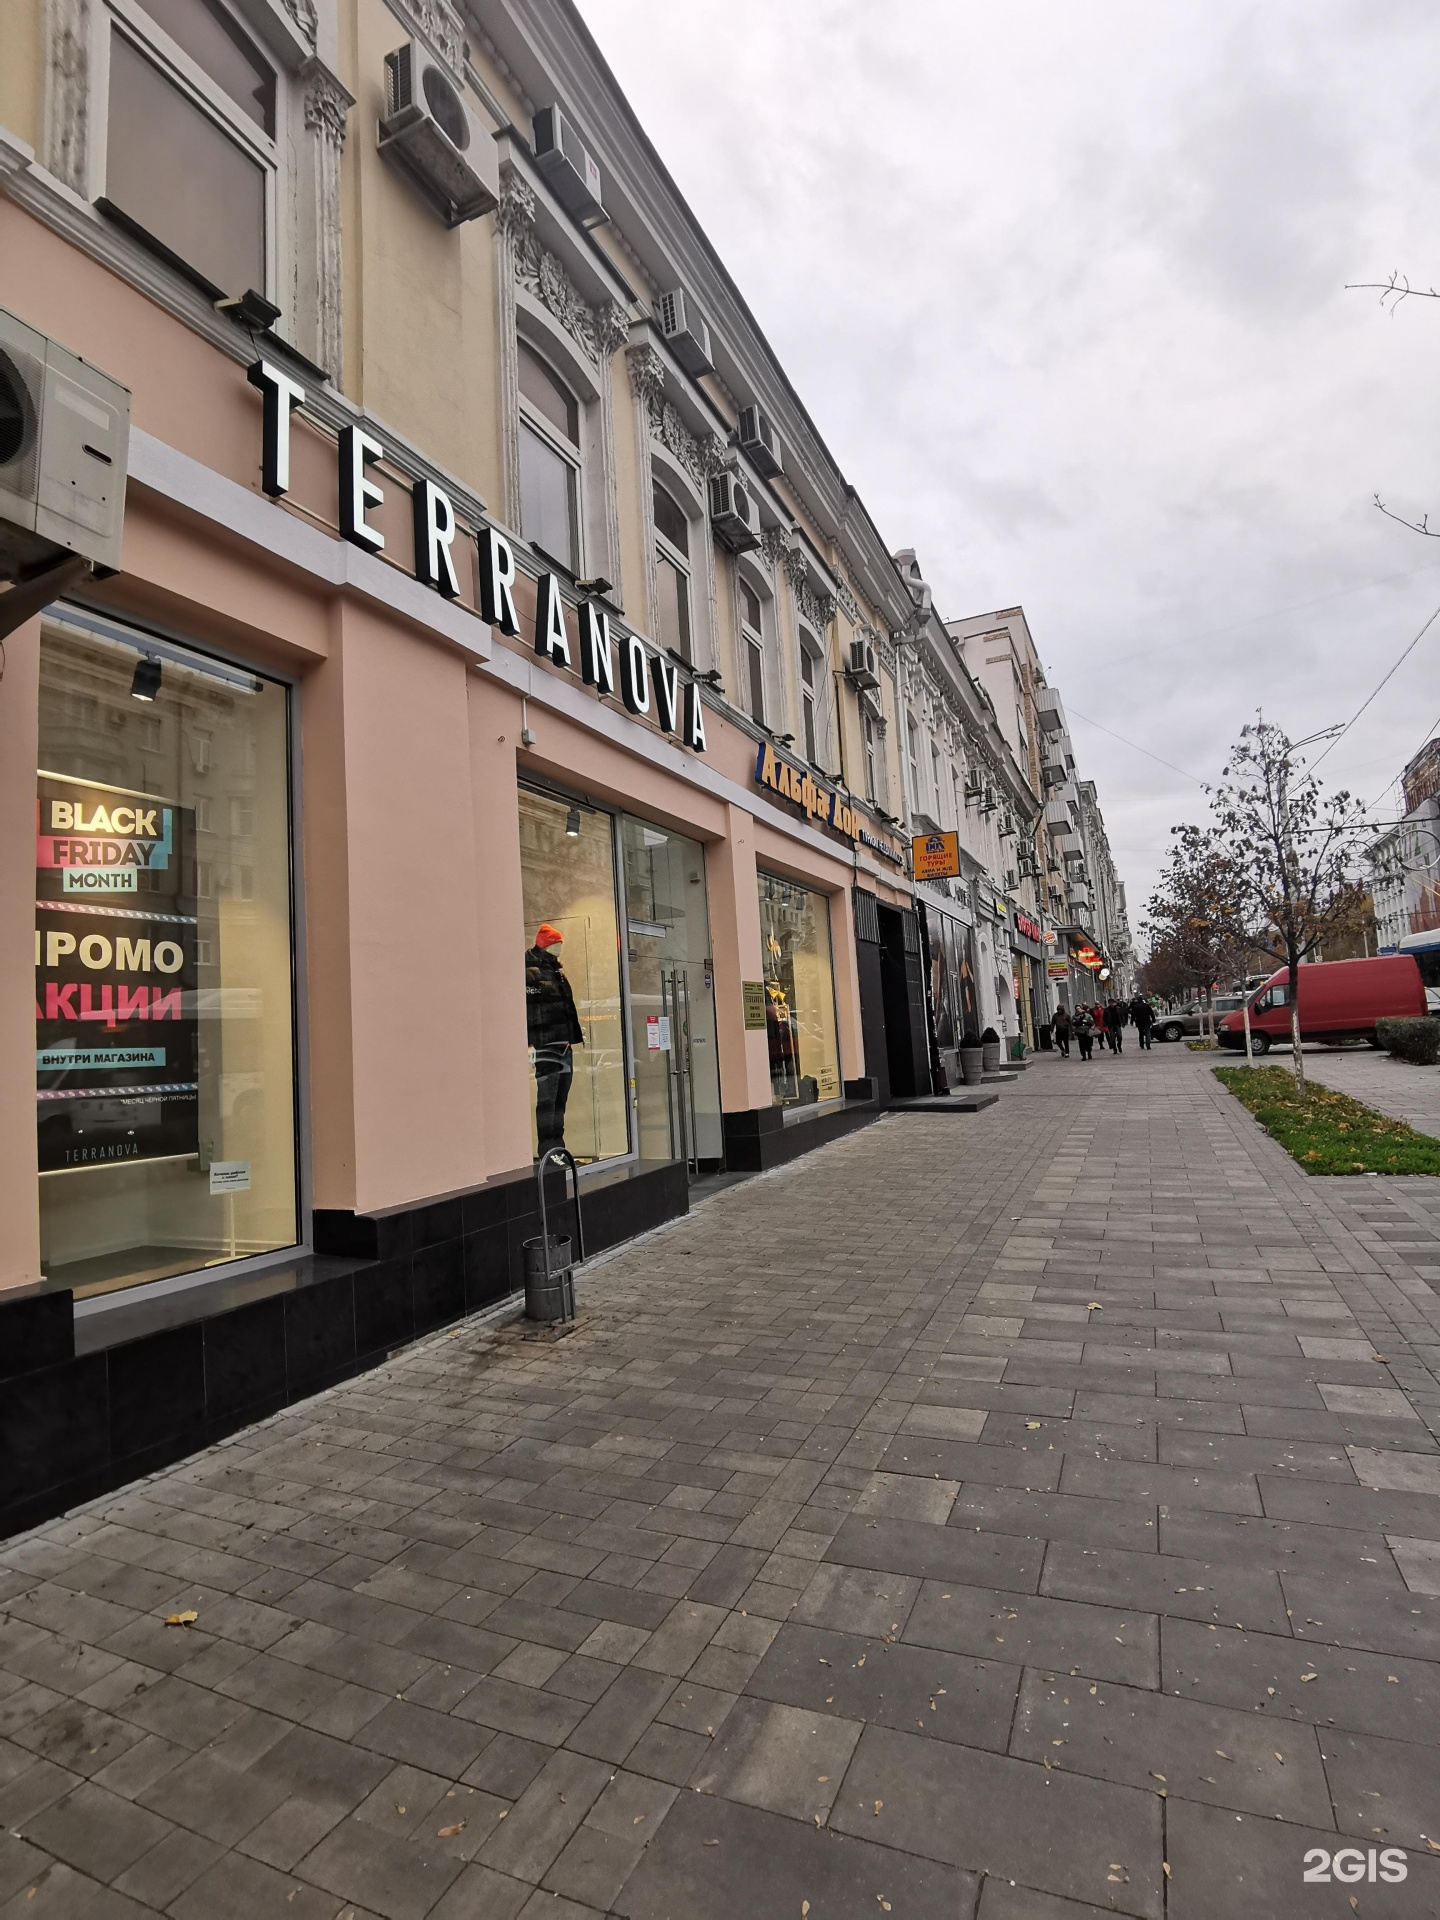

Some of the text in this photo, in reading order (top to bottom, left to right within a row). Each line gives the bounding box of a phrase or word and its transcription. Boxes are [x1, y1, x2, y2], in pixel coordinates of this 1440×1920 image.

[246, 359, 708, 754] TERRANOVA
[51, 800, 157, 836] BLACK
[53, 839, 156, 866] FRIDAY
[919, 853, 953, 862] ГОРЯЩИЕ
[927, 859, 946, 867] ТУРЫ
[69, 872, 132, 888] MONTH
[42, 1052, 156, 1065] ВНУТРИ МАГАЗИНА
[65, 1143, 139, 1163] TERRANOVA
